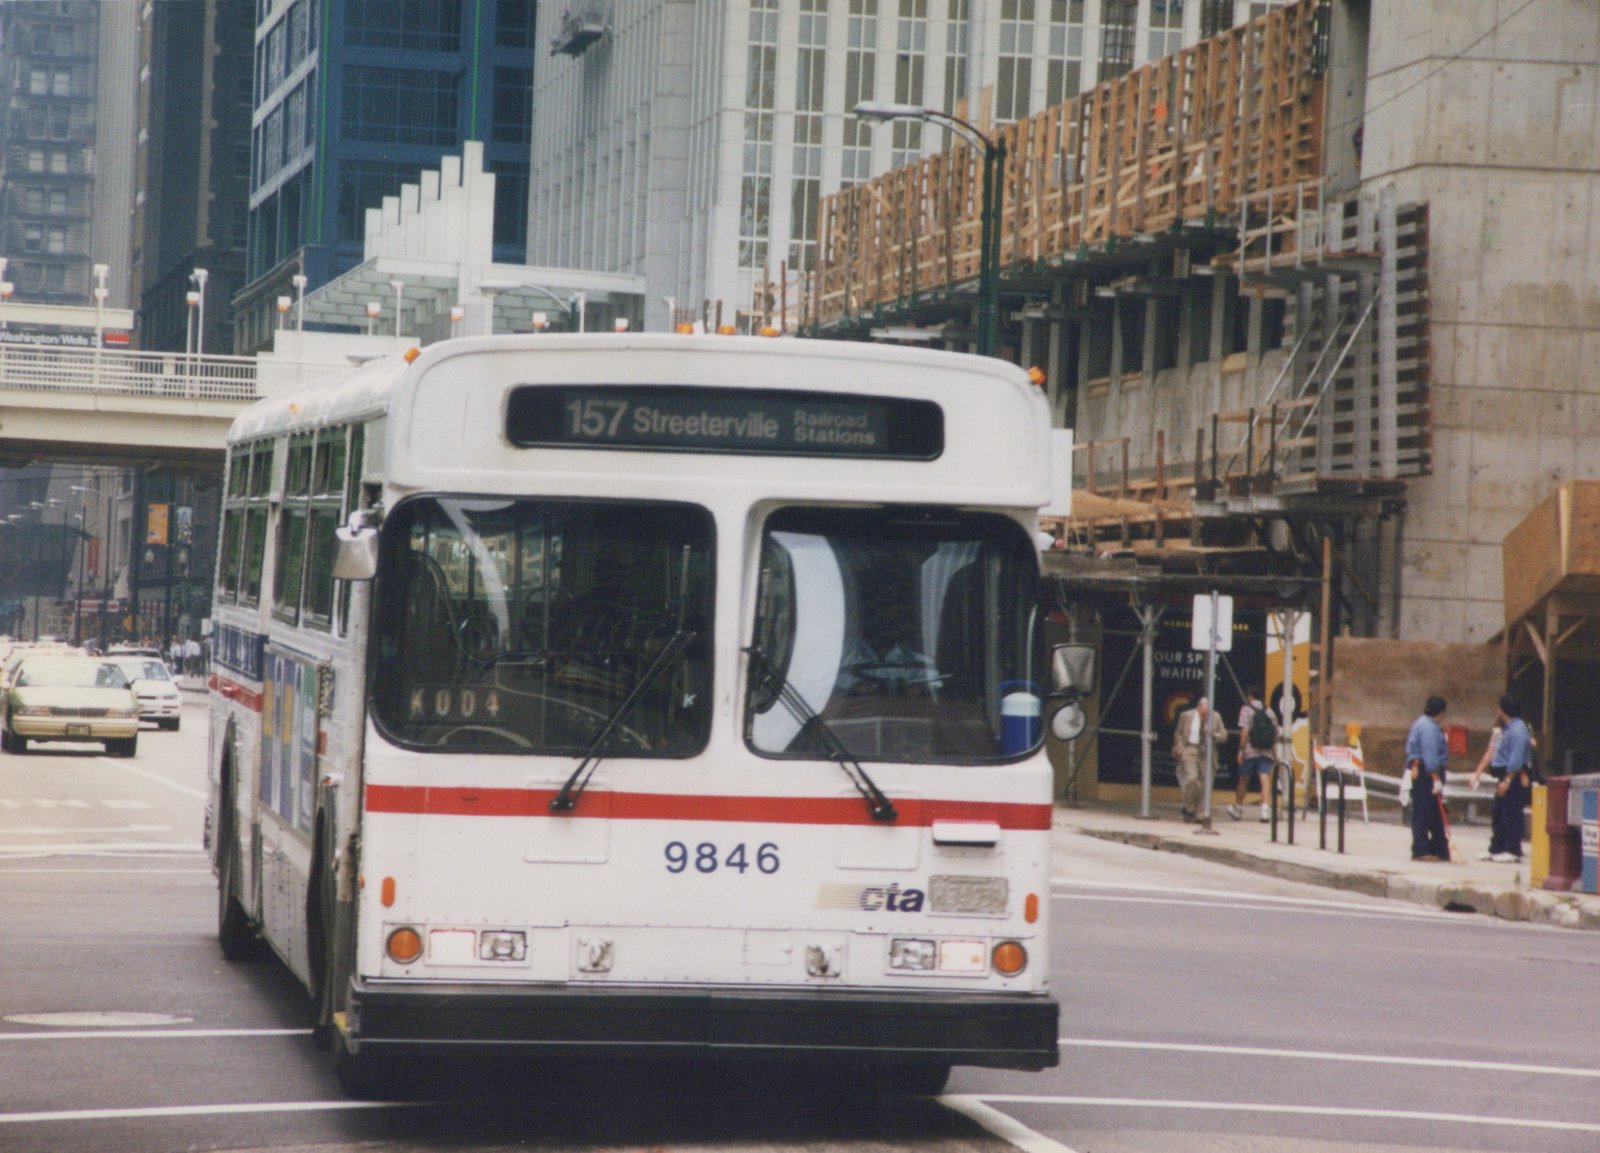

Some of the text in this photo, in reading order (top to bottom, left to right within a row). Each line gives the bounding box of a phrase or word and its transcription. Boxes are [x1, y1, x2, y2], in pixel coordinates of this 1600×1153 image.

[566, 399, 779, 439] 157 Streeterville
[794, 408, 869, 428] Railroad
[794, 426, 876, 445] Stations
[1186, 652, 1221, 666] SPT
[663, 840, 782, 874] 9846
[860, 882, 926, 913] cta
